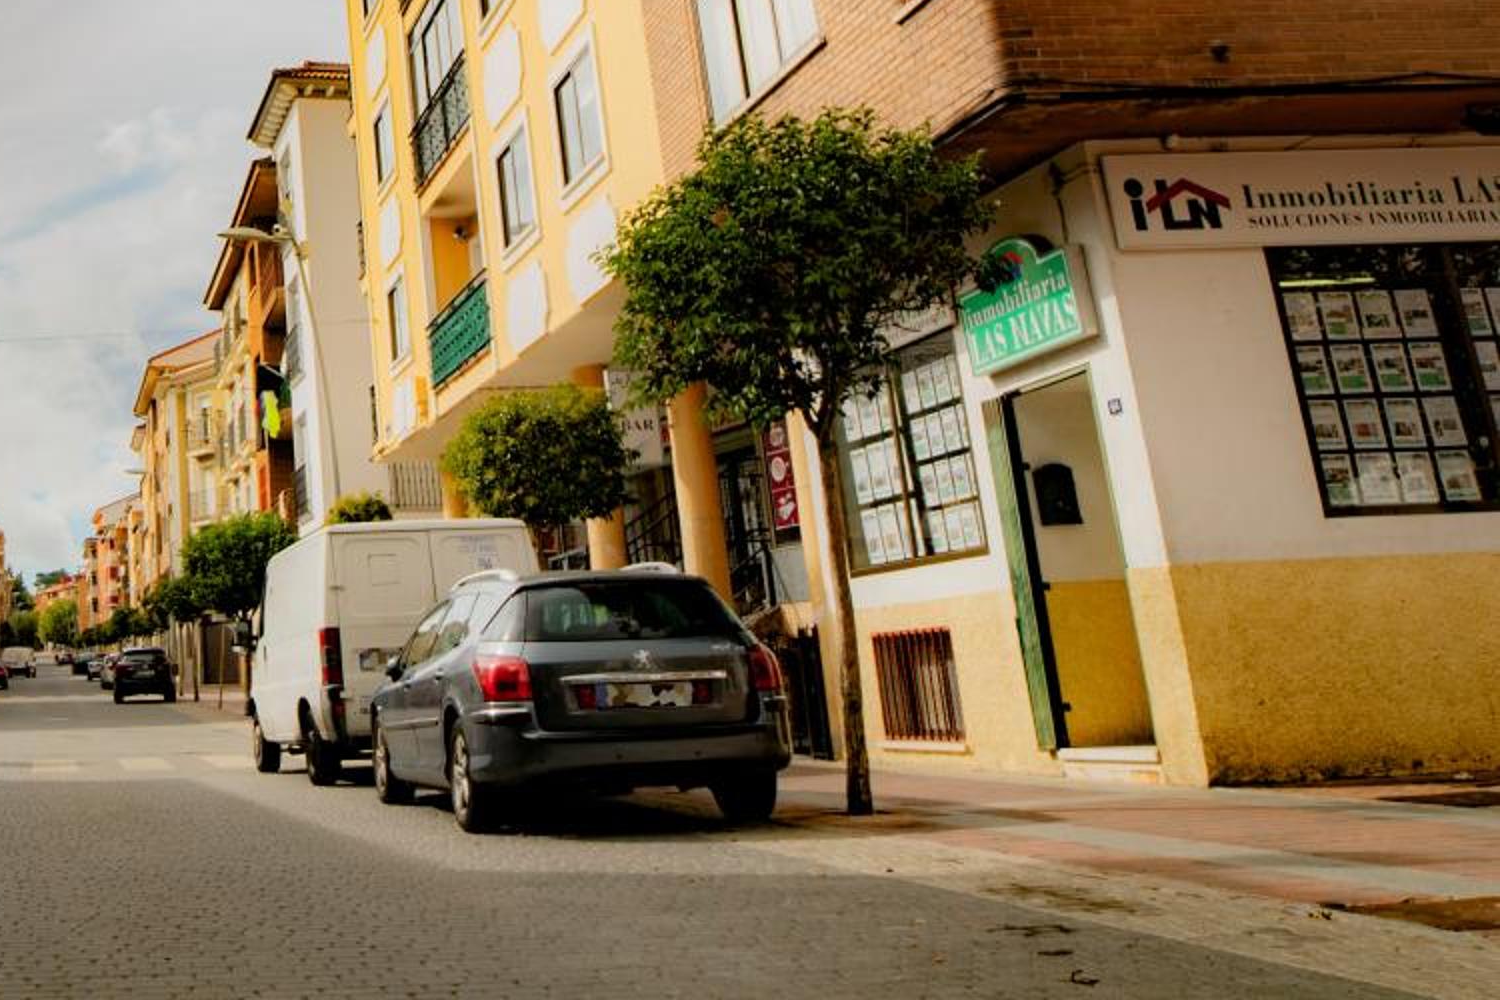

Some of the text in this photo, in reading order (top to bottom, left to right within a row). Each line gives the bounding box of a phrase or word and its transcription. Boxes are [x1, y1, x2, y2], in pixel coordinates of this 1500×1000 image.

[1243, 181, 1445, 209] Inmobiliaria
[1248, 212, 1364, 228] SOLUCIONES
[966, 292, 1078, 363] LAS NAVAS
[620, 418, 654, 432] BAR
